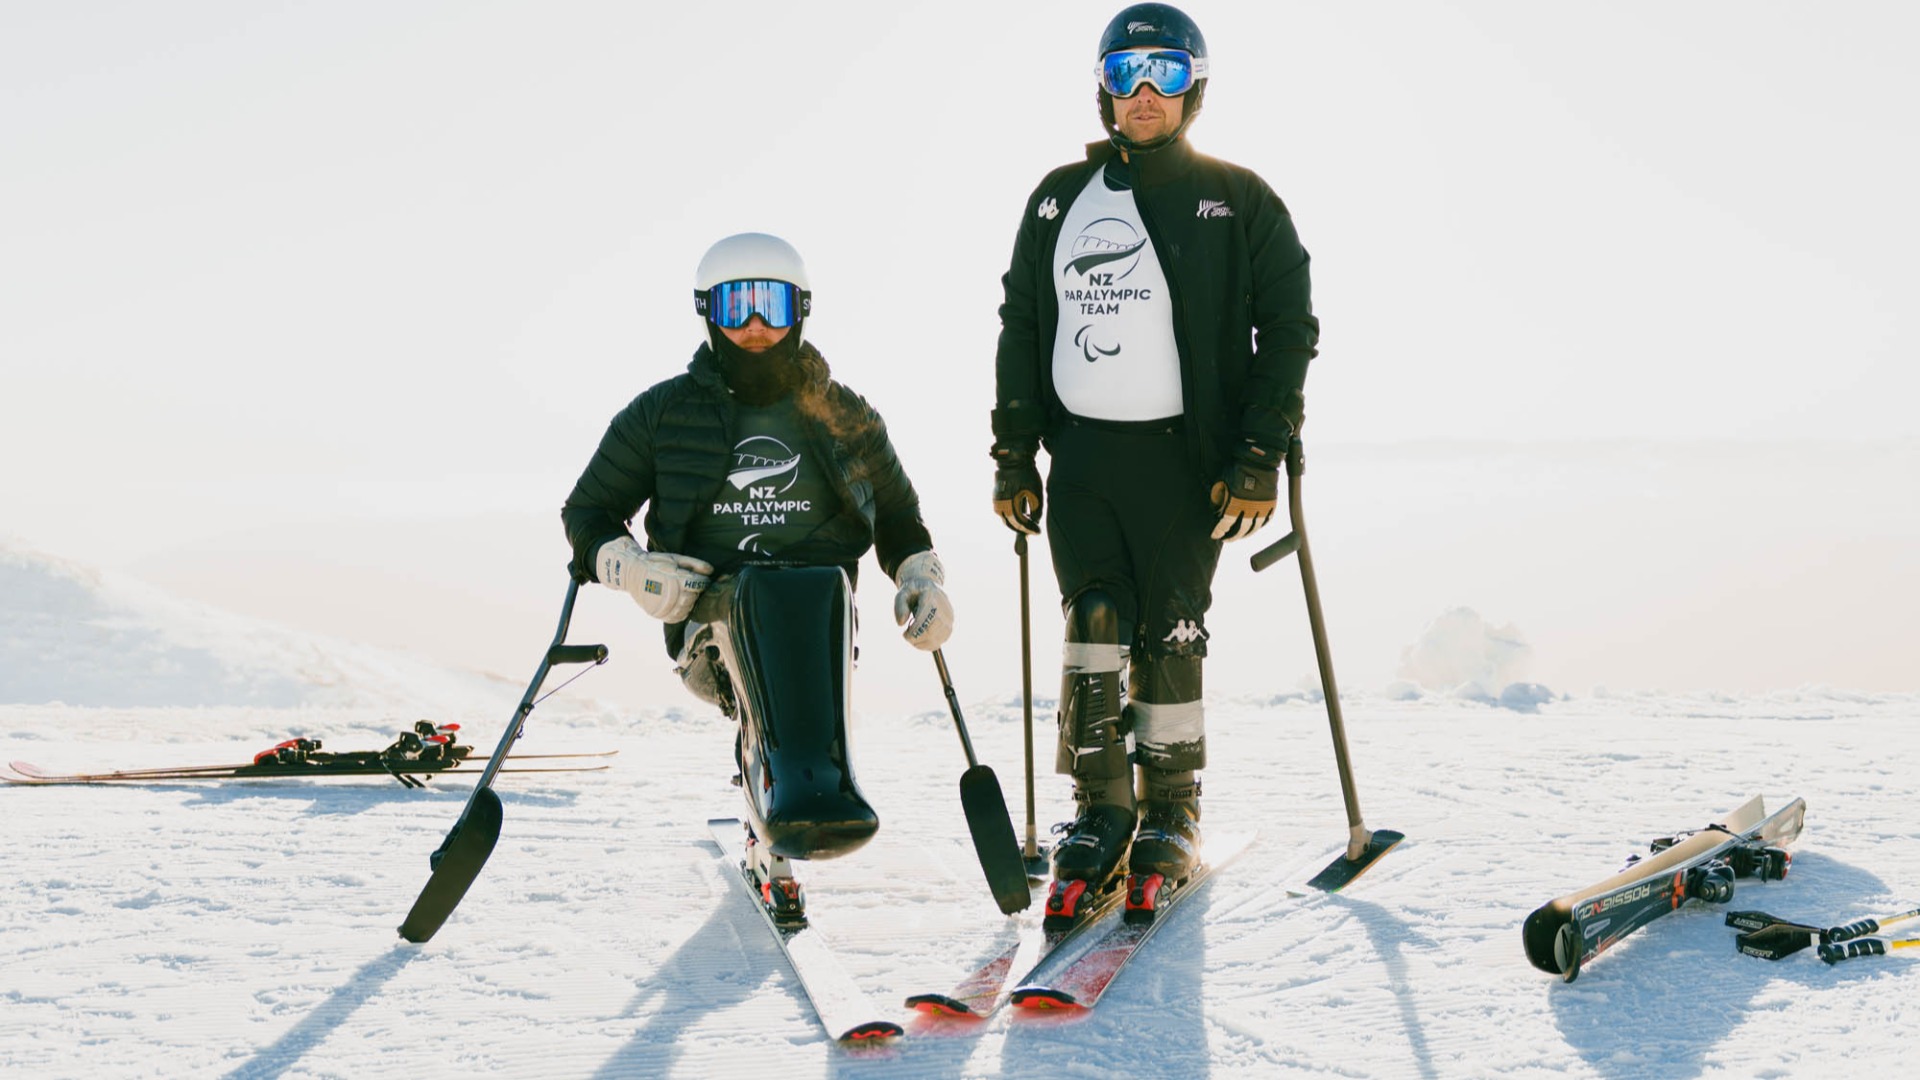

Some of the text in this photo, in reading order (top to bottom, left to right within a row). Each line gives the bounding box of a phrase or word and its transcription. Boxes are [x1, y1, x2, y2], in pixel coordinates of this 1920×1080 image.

[1089, 273, 1113, 287] NZ
[1065, 288, 1152, 301] PARALYMPIC
[1080, 303, 1120, 315] TEAM
[750, 486, 776, 499] NZ
[713, 500, 811, 515] PARALYMPIC
[741, 513, 785, 525] TEAM
[911, 607, 938, 639] HESTRA
[1578, 883, 1651, 920] ROSSIGNOL
